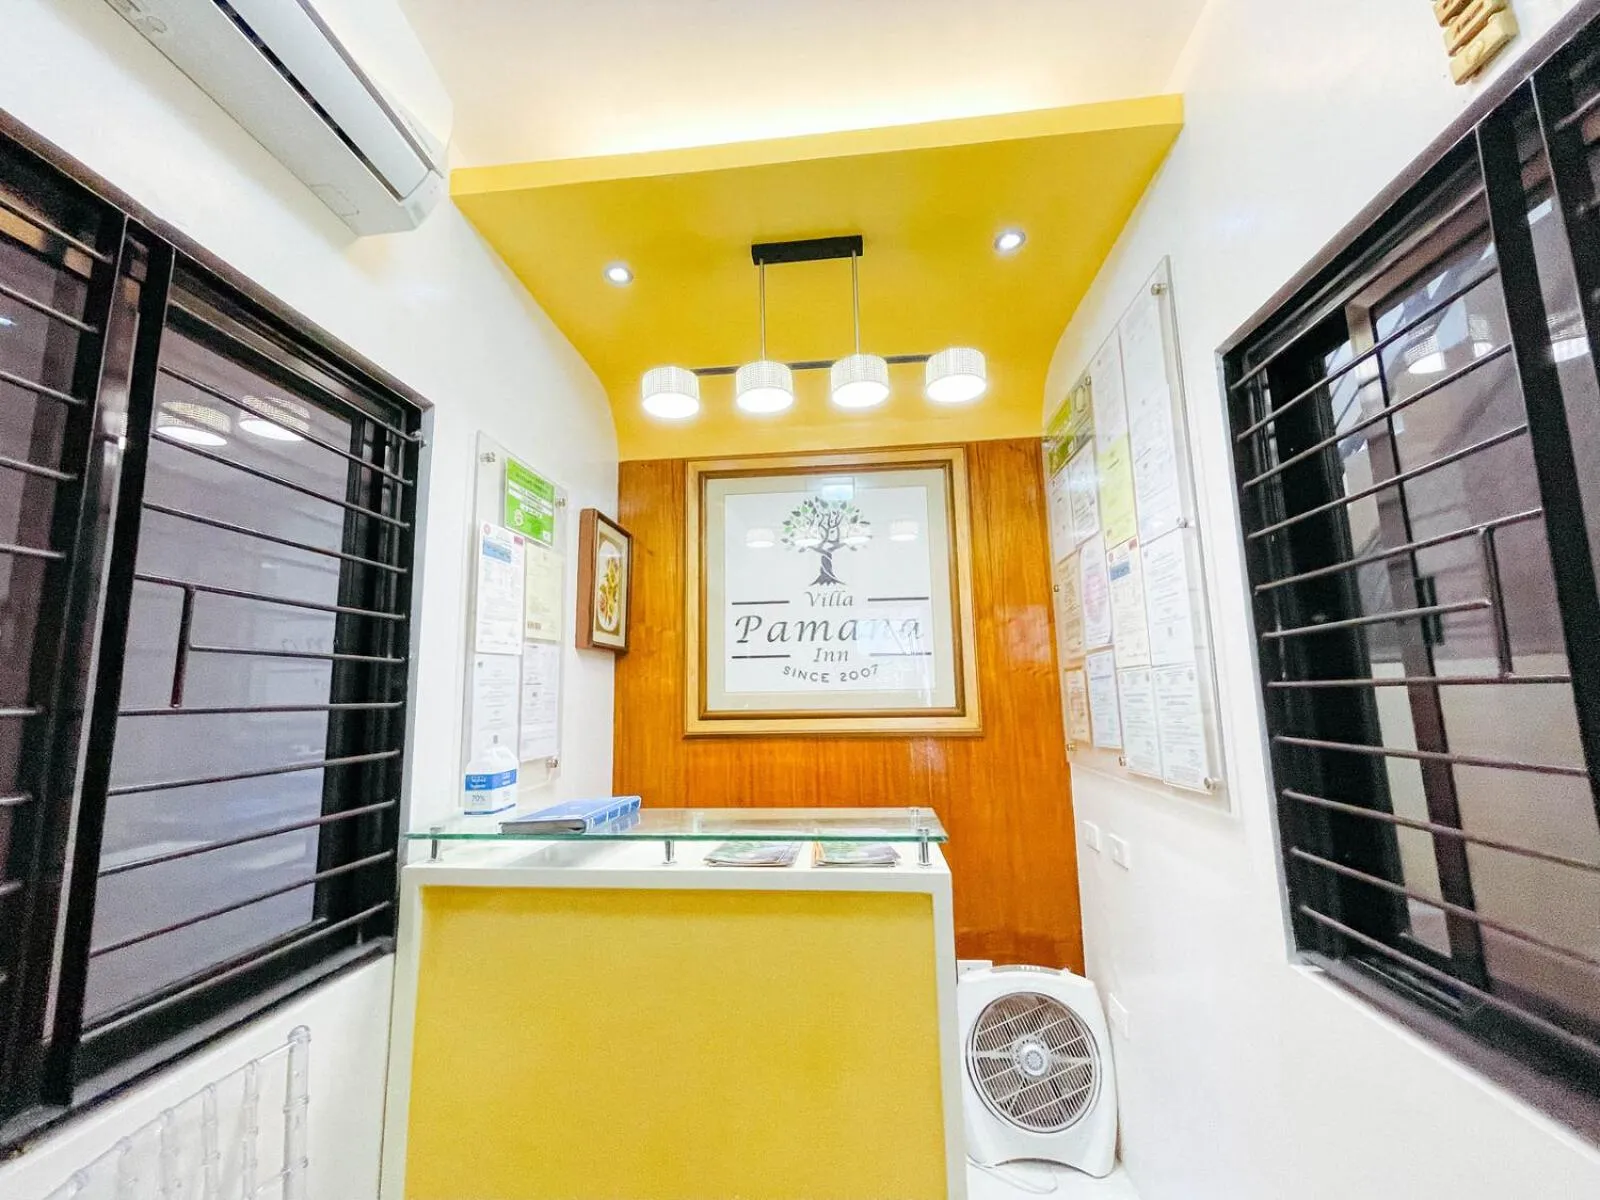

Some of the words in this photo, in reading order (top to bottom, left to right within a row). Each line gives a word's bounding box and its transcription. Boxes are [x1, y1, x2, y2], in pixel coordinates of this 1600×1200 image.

[805, 591, 854, 607] Villa
[813, 647, 849, 663] Inn
[783, 666, 830, 683] SINCE
[840, 664, 879, 682] 2007
